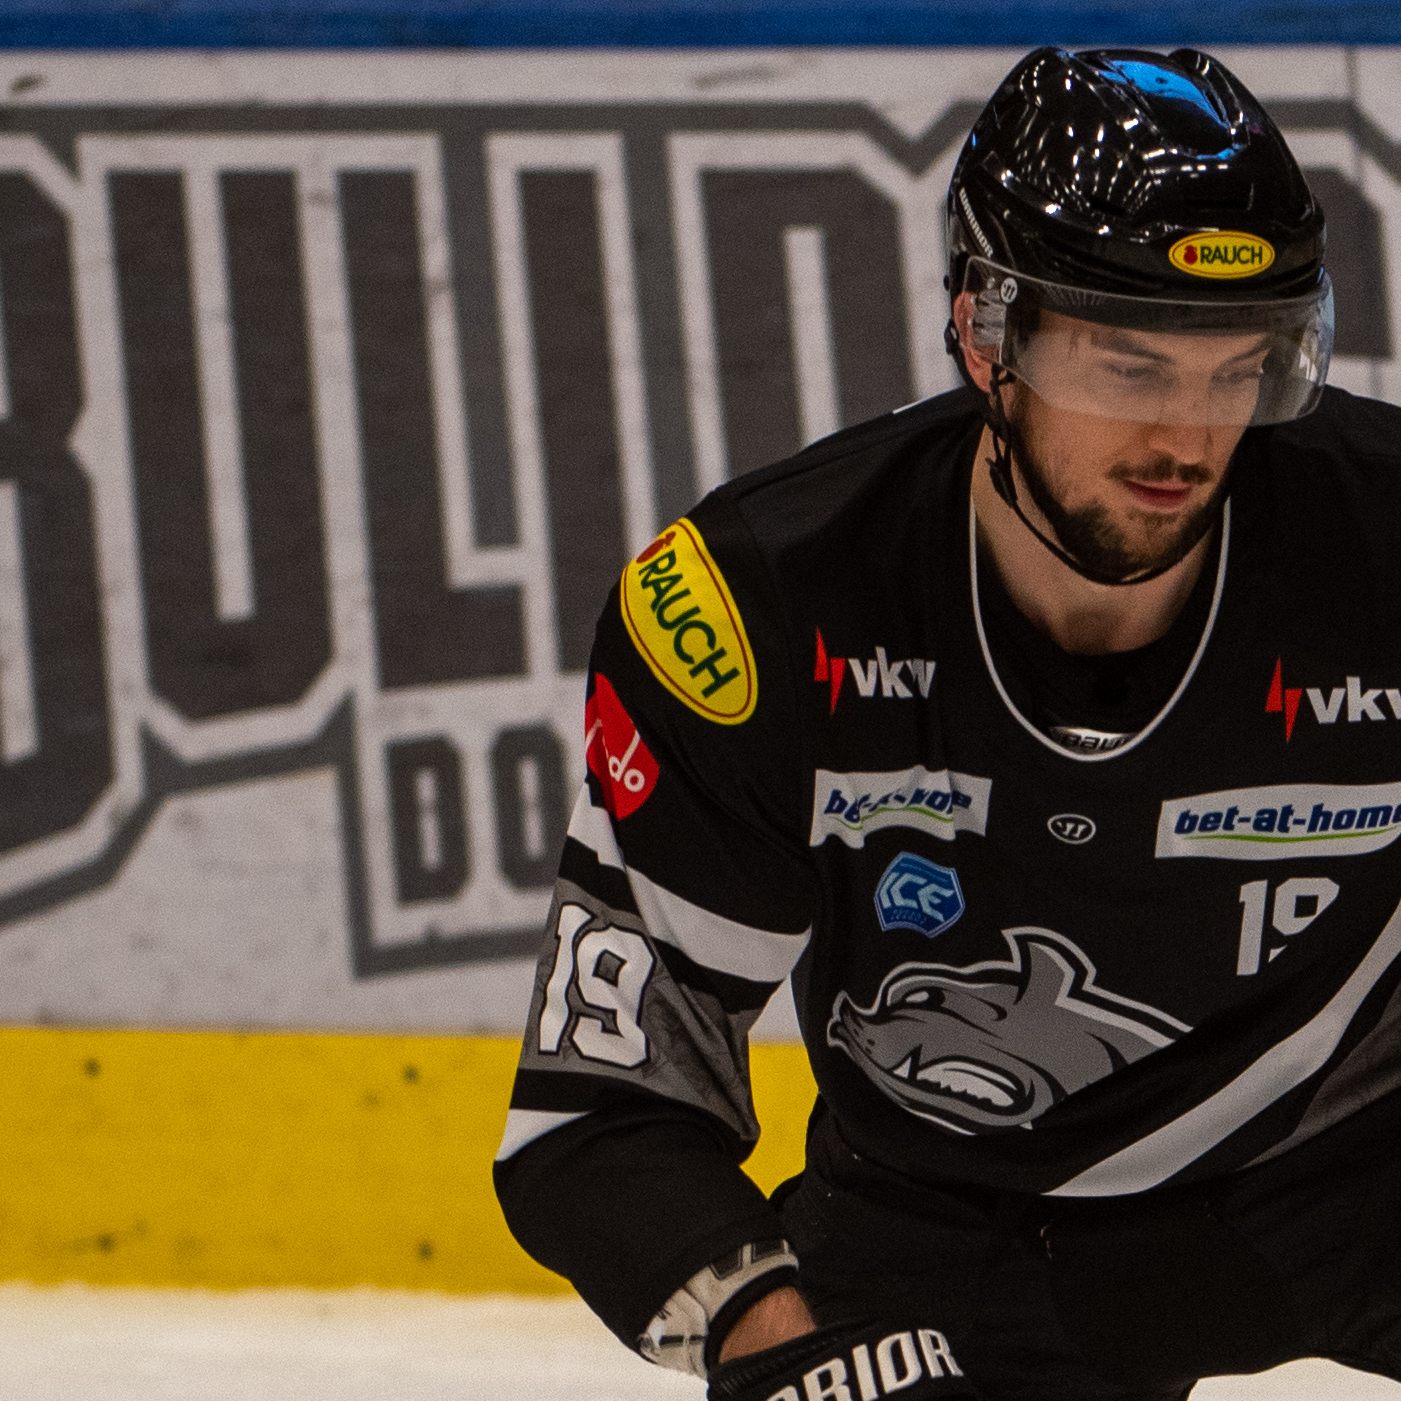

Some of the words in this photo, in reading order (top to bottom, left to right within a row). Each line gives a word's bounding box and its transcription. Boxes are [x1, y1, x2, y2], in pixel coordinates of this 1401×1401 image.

[1199, 246, 1263, 265] RAUCH
[638, 549, 740, 699] RAUCH
[880, 872, 955, 922] ICE
[1236, 877, 1340, 976] 19
[538, 901, 657, 1070] 19
